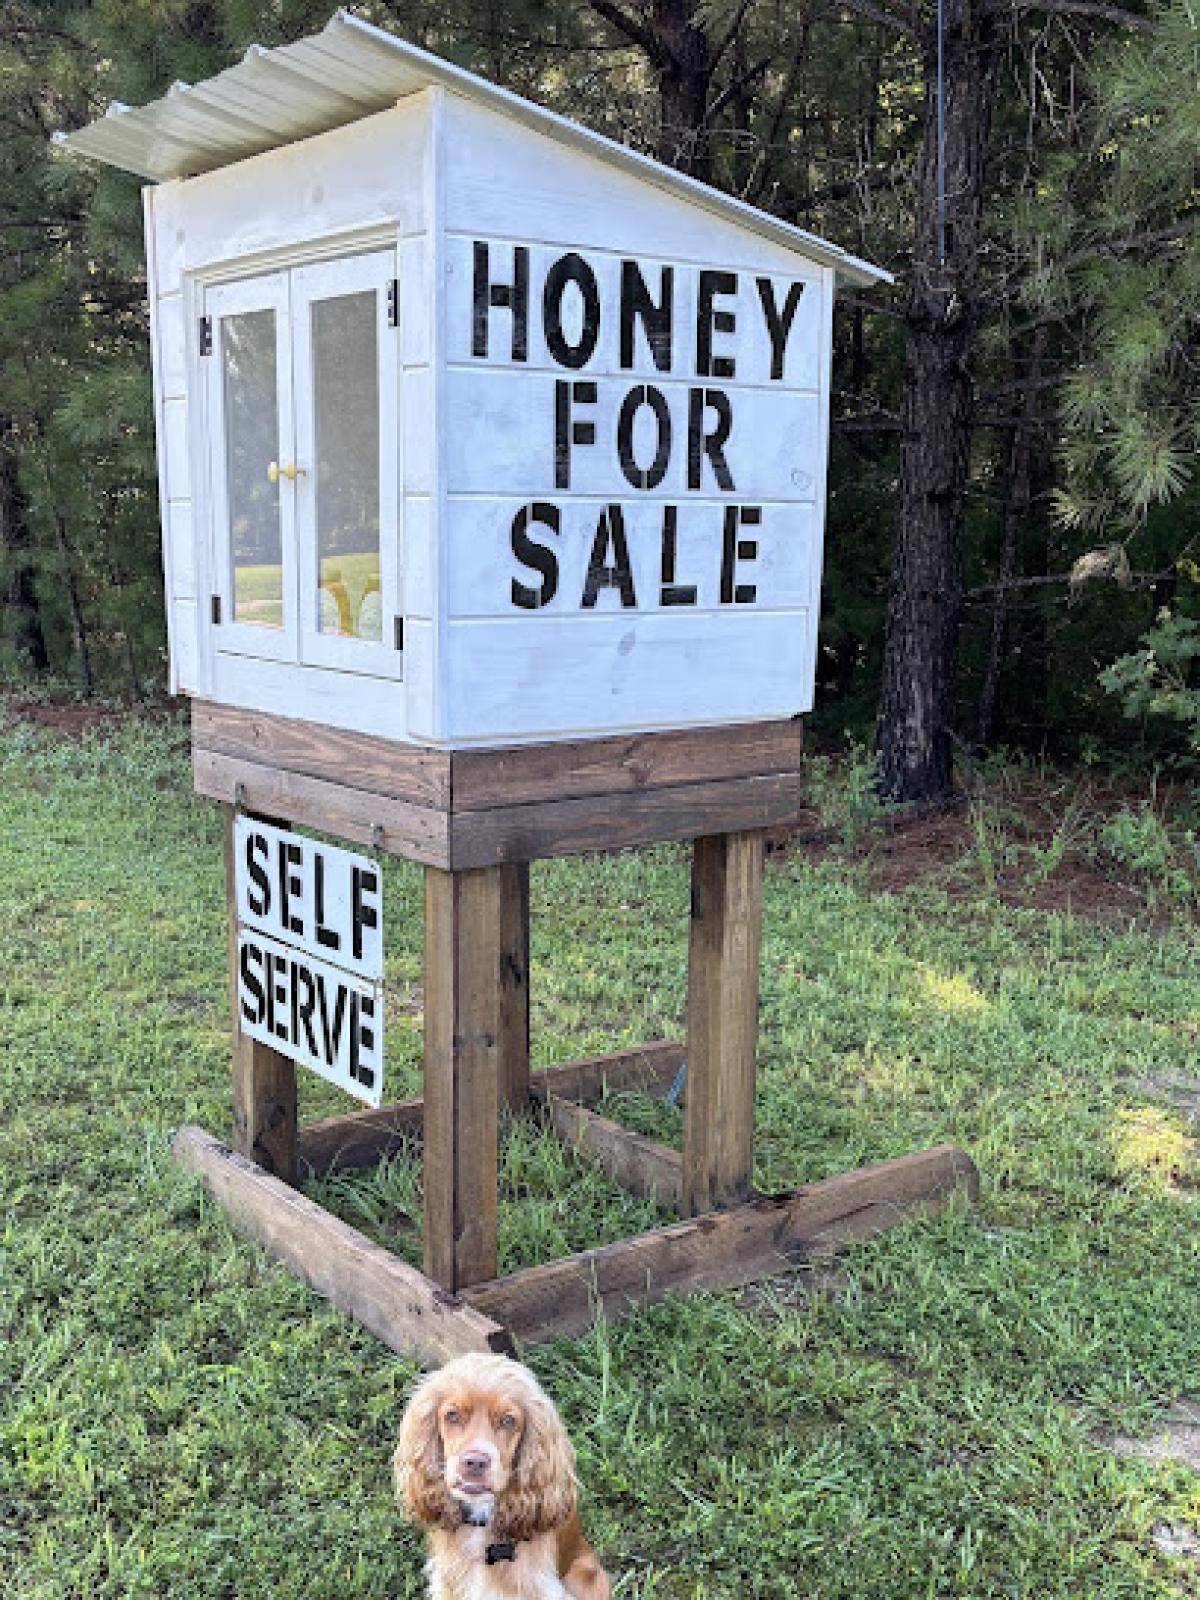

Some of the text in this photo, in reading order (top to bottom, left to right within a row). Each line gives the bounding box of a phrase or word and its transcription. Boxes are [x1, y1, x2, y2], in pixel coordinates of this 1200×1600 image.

[471, 240, 806, 380] HONEY
[553, 378, 737, 492] FOR
[511, 502, 763, 610] SALE
[246, 832, 378, 960] SELF
[240, 943, 375, 1089] SERVE
